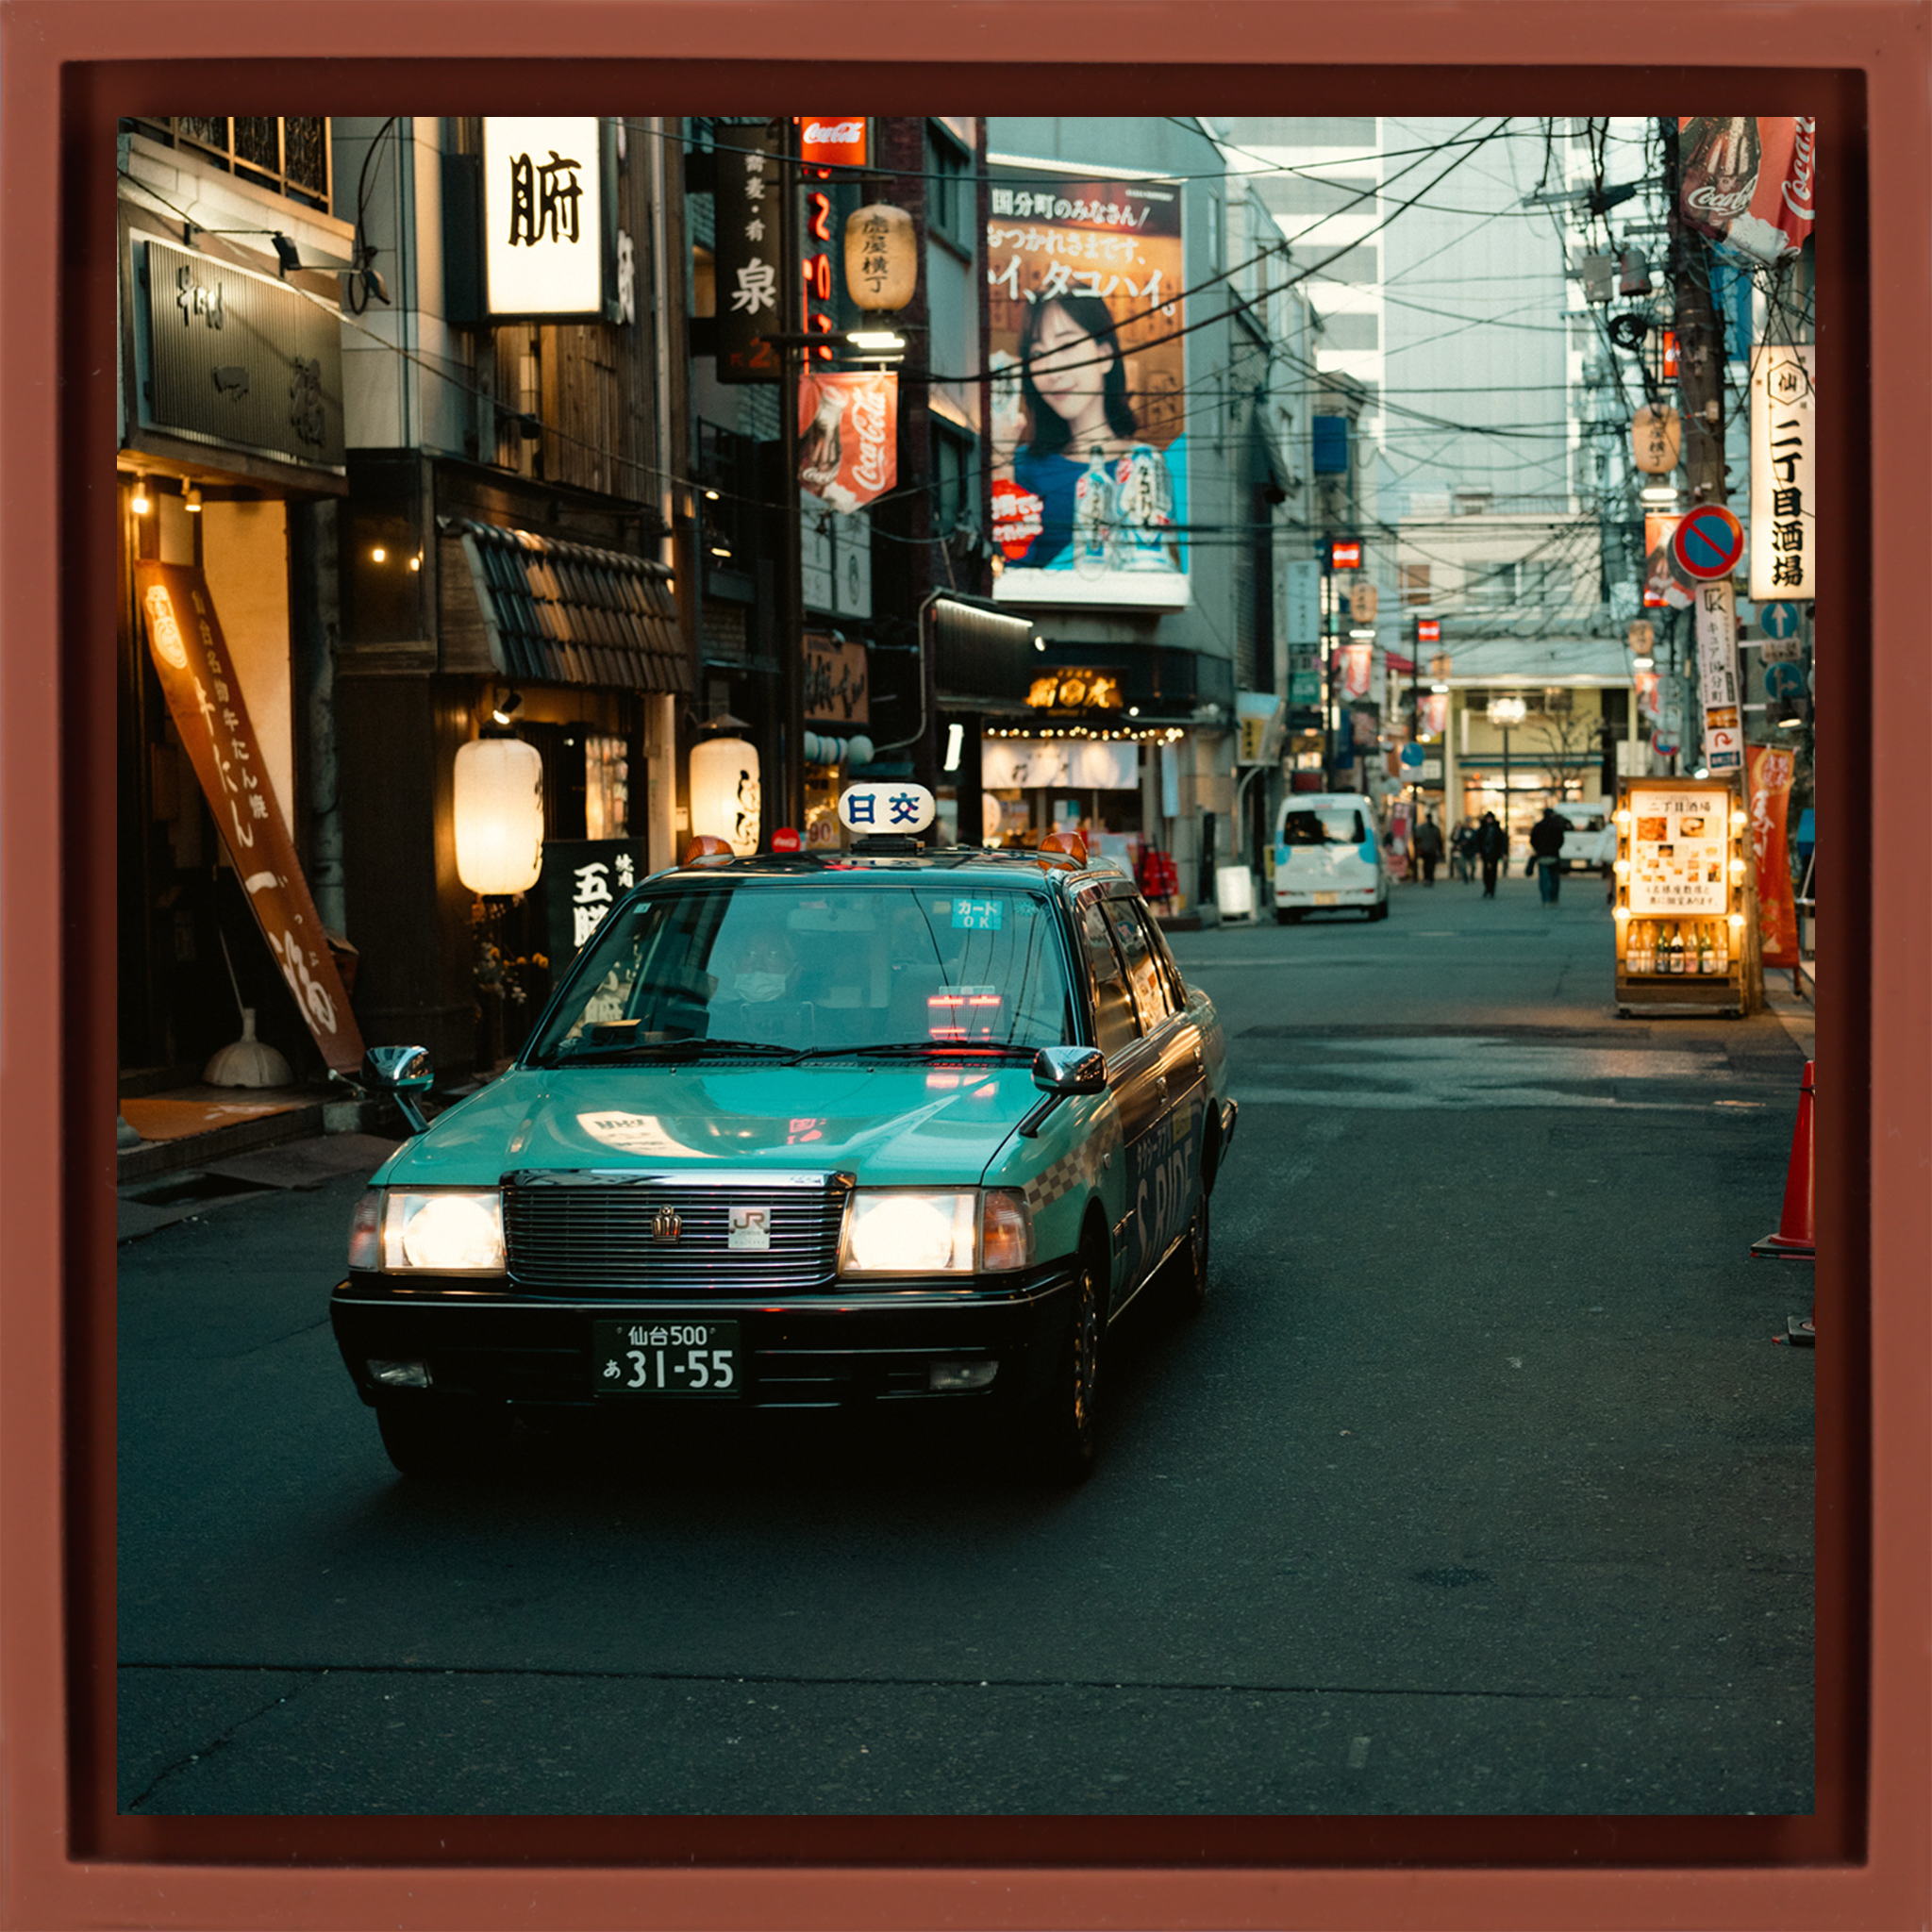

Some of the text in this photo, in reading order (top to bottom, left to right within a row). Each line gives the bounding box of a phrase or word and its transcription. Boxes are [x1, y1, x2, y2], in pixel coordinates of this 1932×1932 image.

[803, 122, 864, 143] Coca-Cola
[508, 150, 584, 248] 腑
[730, 257, 777, 315] 泉
[851, 386, 887, 491] Coca-Cola
[1771, 419, 1804, 587] 二丁目酒場
[847, 792, 920, 824] 日交
[958, 901, 997, 915] カード
[733, 1212, 766, 1229] JR
[603, 1350, 734, 1388] あ 31-55
